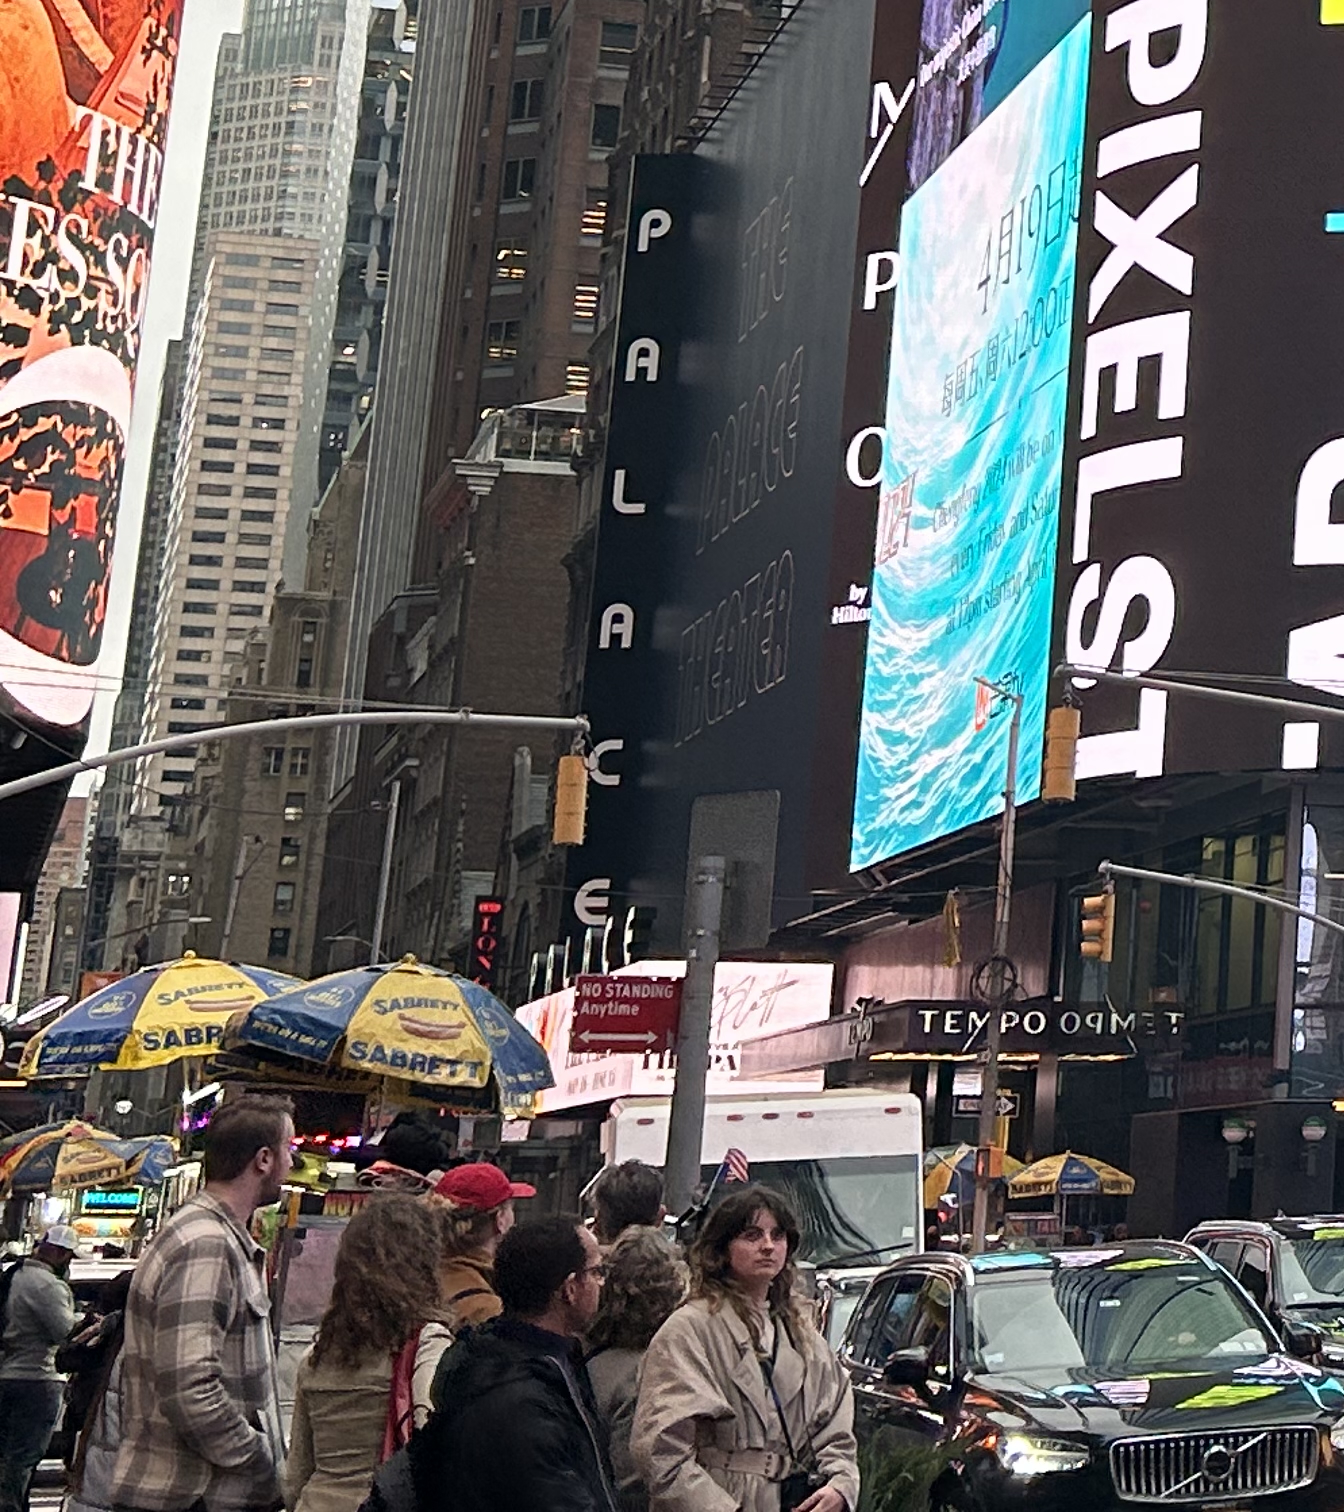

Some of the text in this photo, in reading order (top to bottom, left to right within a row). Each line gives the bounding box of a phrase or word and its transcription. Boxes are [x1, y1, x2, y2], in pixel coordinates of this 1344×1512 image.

[75, 104, 163, 230] THE
[3, 193, 90, 305] ES
[574, 207, 673, 927] PALACE
[850, 584, 869, 604] by
[581, 982, 674, 999] NO STANDING
[580, 1002, 640, 1021] Anytime
[917, 1009, 1047, 1053] TEMPO
[142, 1025, 224, 1052] SABR
[348, 1039, 483, 1080] SABRETT
